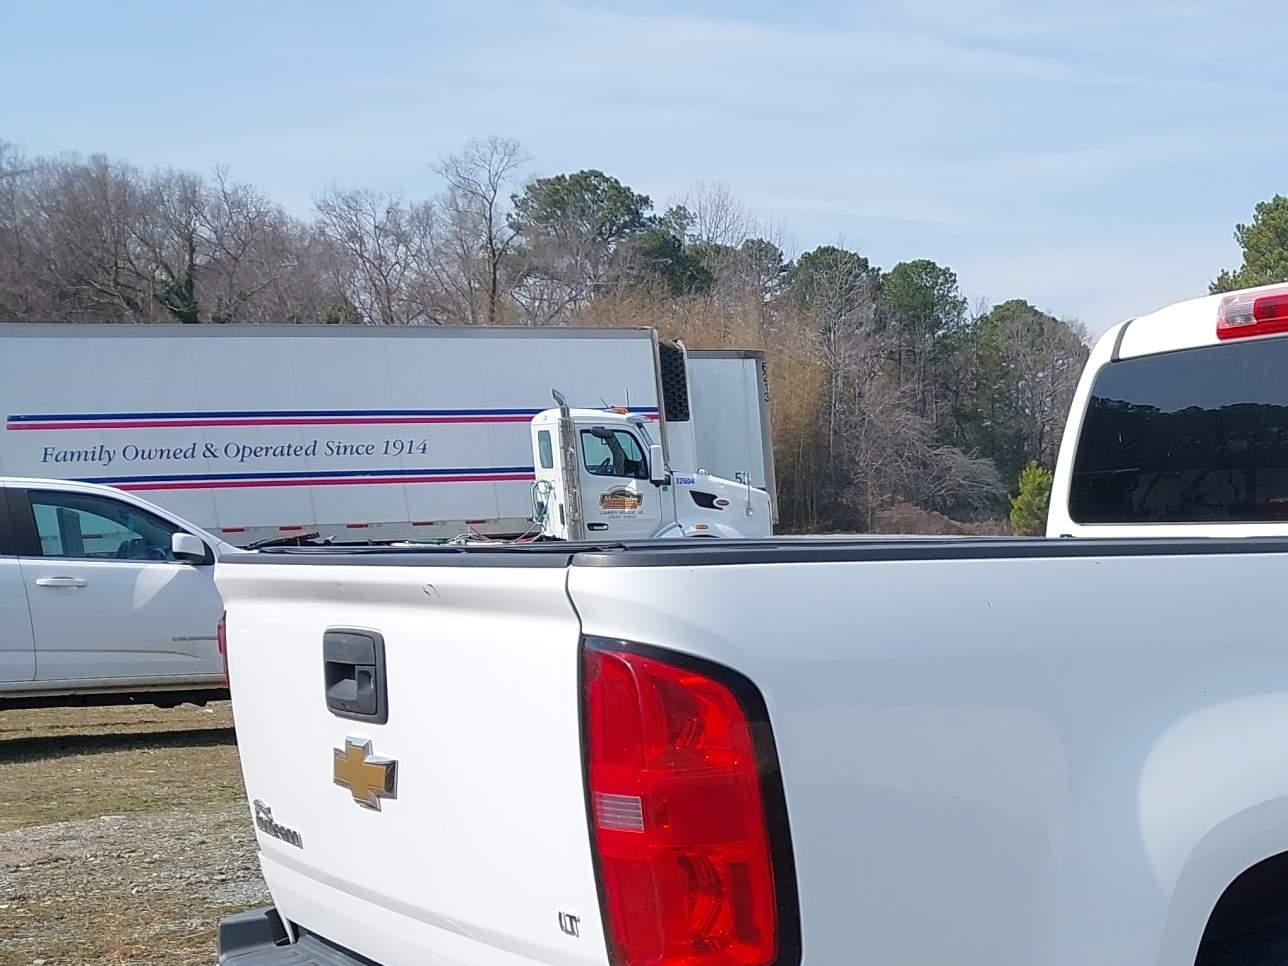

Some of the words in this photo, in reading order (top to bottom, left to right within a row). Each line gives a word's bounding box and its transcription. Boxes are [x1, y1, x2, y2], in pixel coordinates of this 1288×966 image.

[41, 445, 116, 466] Family
[122, 443, 197, 461] Owned
[202, 443, 219, 458] &
[223, 440, 318, 463] Operated
[324, 440, 375, 457] Since
[382, 439, 429, 456] 1914
